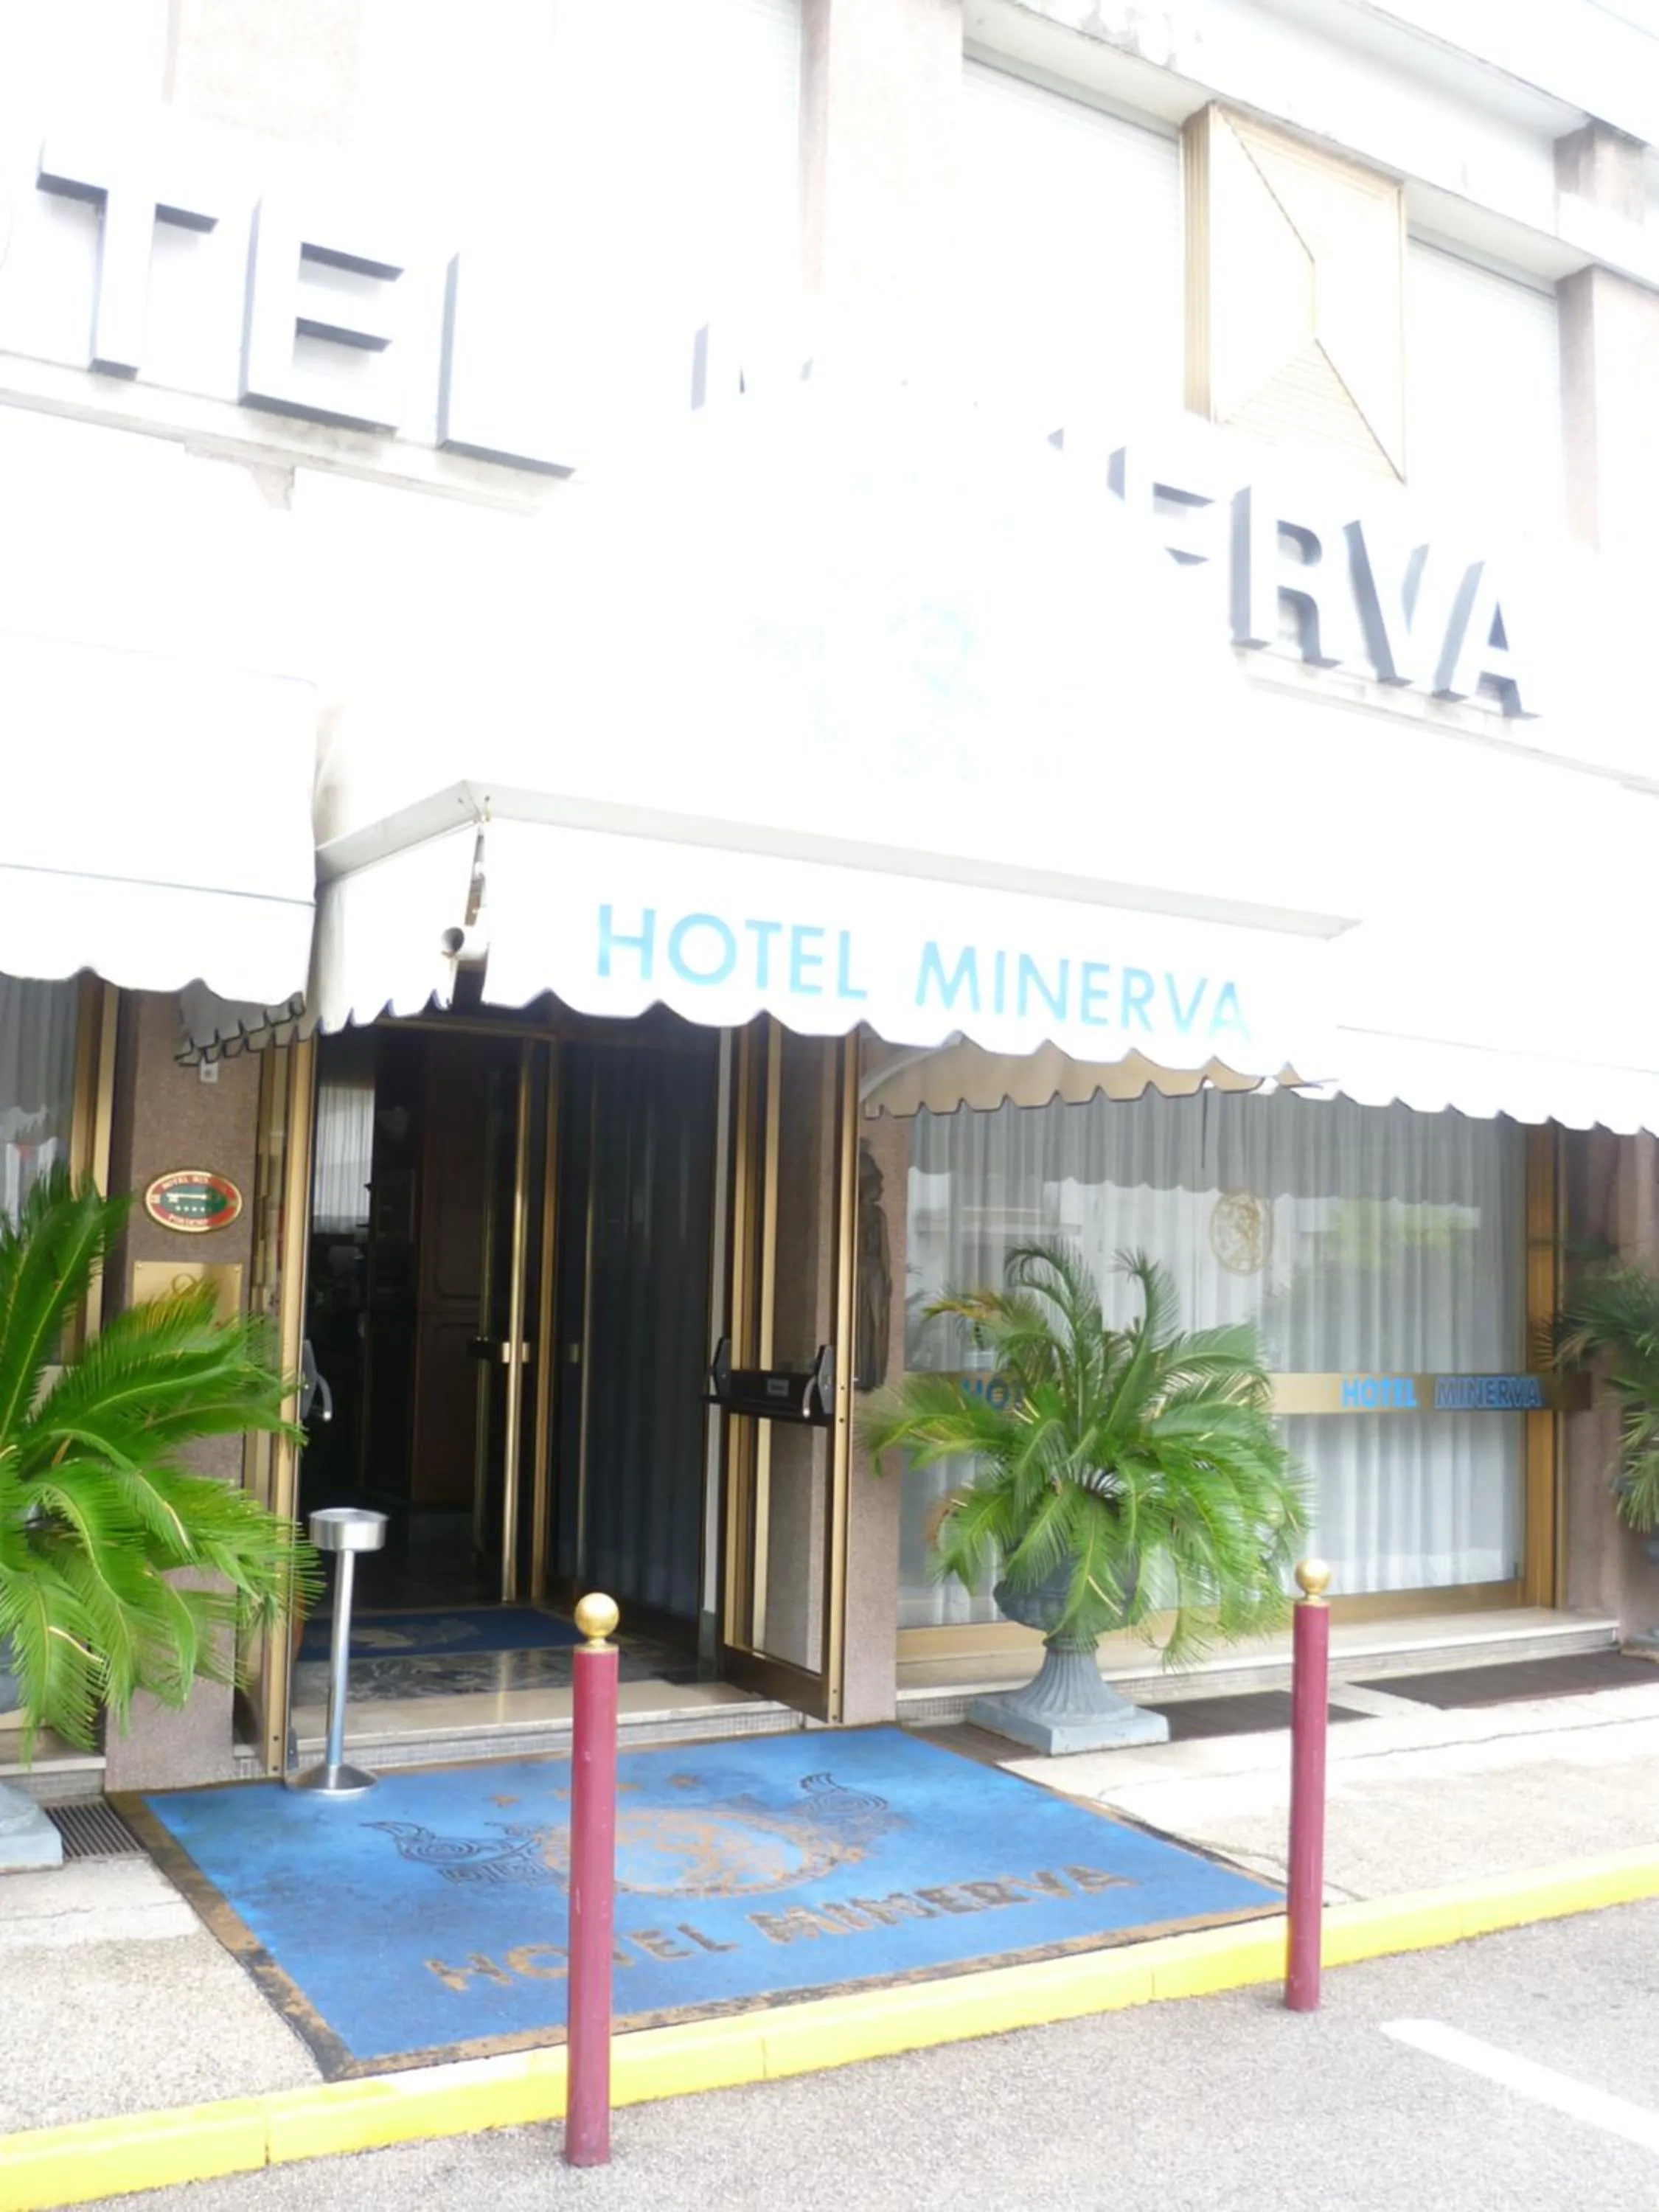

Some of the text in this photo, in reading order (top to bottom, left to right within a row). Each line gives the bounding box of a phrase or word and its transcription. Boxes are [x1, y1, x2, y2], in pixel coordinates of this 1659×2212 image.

[596, 902, 1251, 1041] HOTEL MINERVA
[1341, 1376, 1416, 1408] HOTEL
[1434, 1376, 1543, 1409] MINERVA
[749, 1865, 1139, 1944] MINERVA
